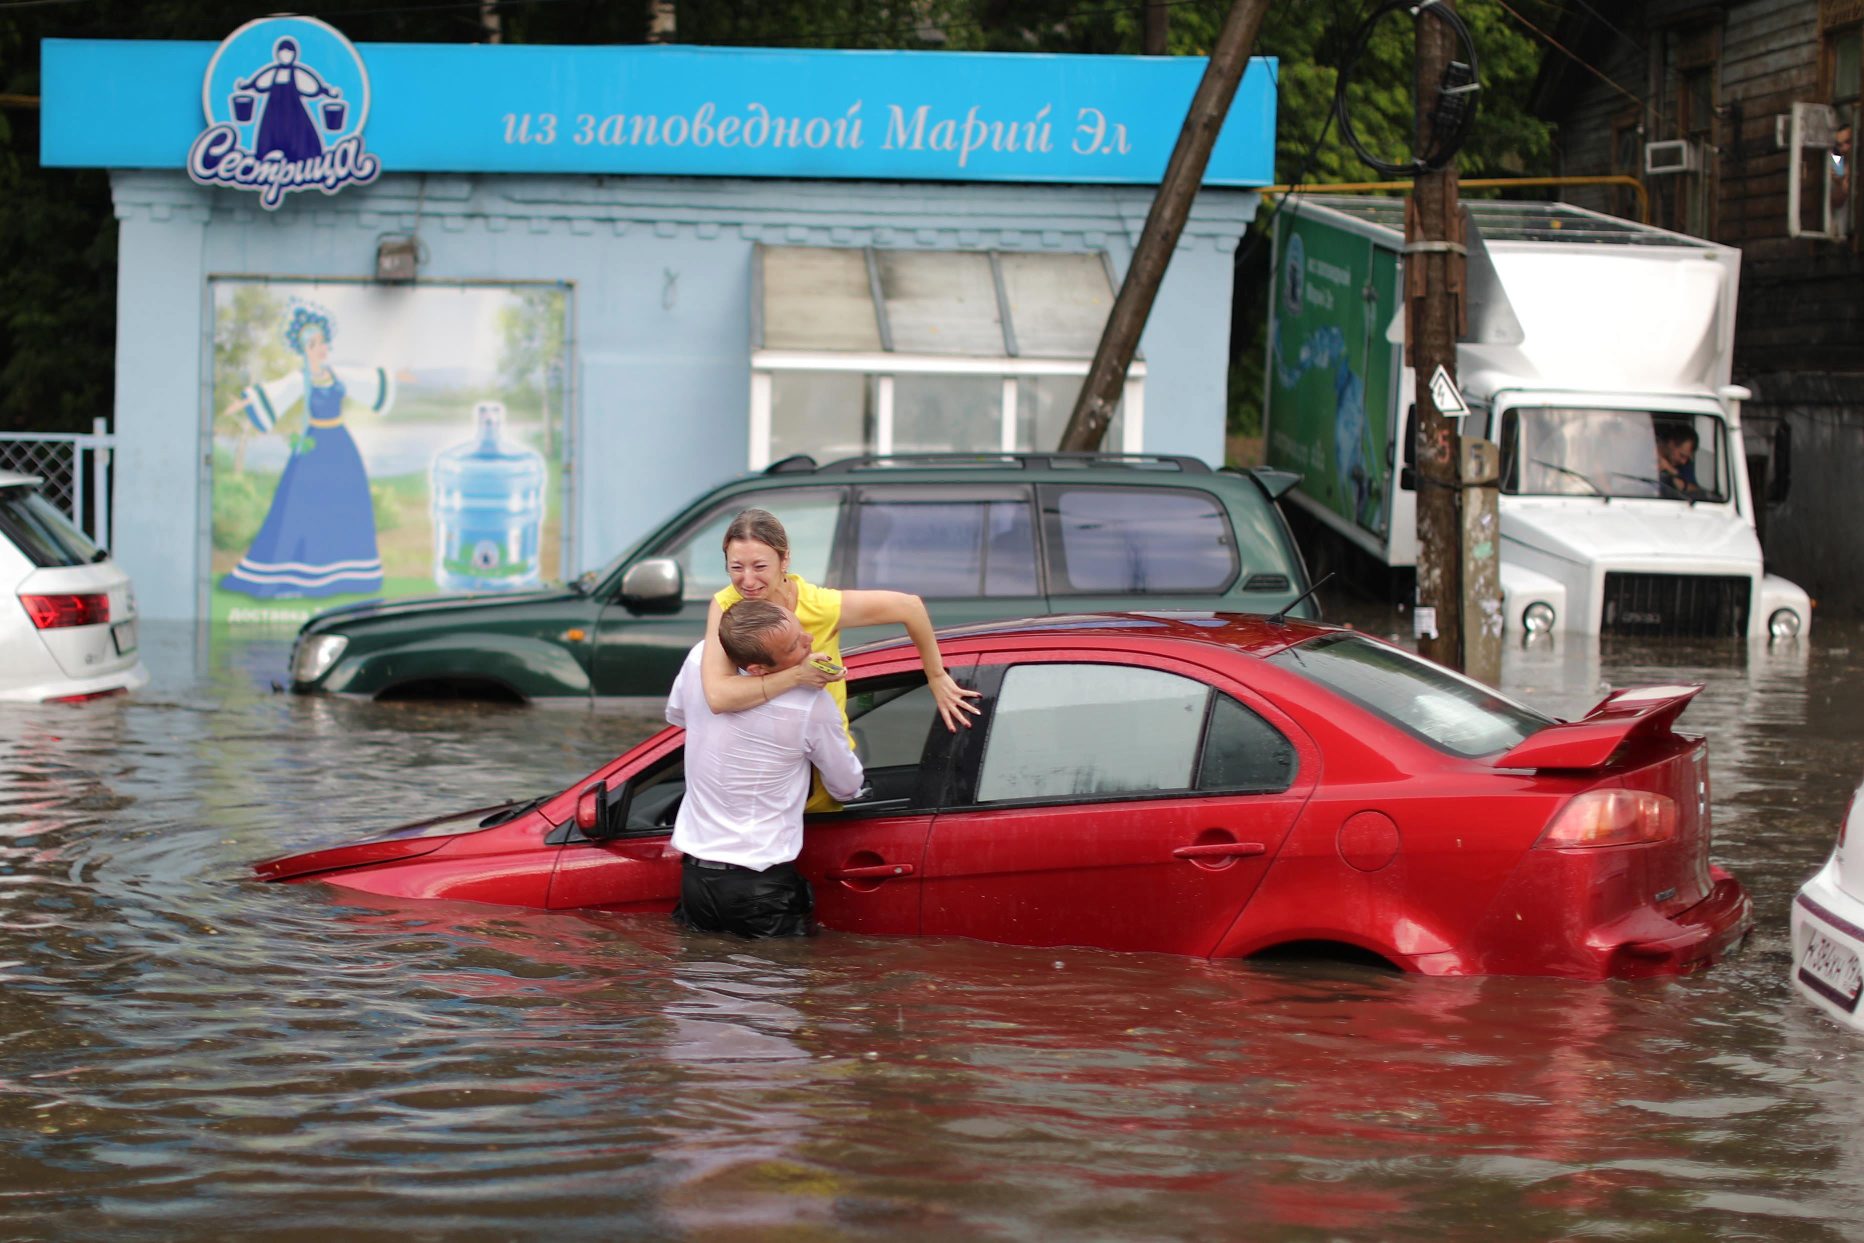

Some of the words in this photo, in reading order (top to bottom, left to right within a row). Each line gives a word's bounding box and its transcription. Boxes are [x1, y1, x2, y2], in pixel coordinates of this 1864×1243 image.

[191, 124, 376, 205] Сестрица
[503, 113, 558, 145] из
[573, 100, 865, 150] заповедной
[881, 102, 1055, 168] Марий
[1072, 107, 1132, 155] Эл
